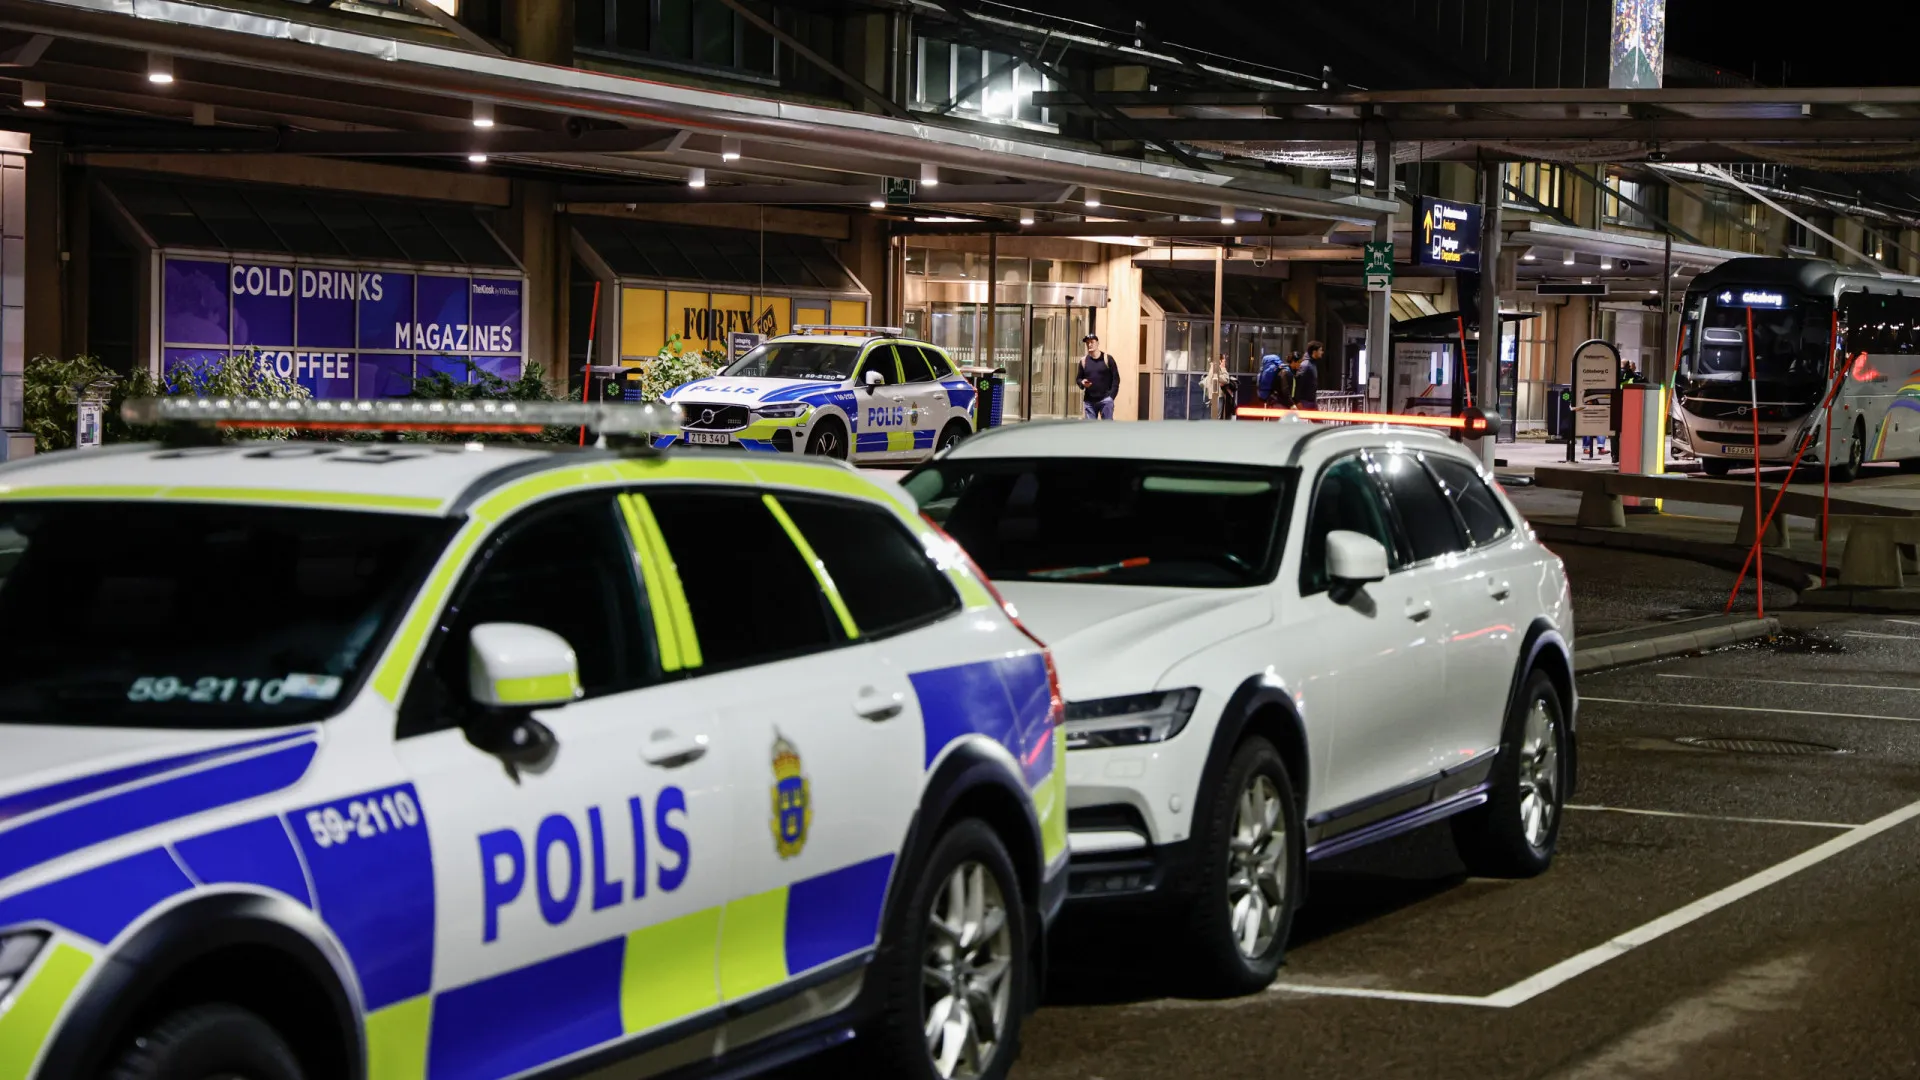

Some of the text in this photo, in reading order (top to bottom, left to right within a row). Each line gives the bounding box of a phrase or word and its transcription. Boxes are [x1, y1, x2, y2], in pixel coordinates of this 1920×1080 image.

[231, 266, 383, 301] COLD DRINKS
[395, 322, 513, 352] MAGAZINES
[260, 351, 349, 379] COFFEE
[868, 406, 903, 427] POLIS
[691, 433, 726, 444] ZTB 340
[128, 676, 286, 704] 59-2110
[305, 791, 419, 849] 59-2110
[478, 785, 691, 944] POLIS
